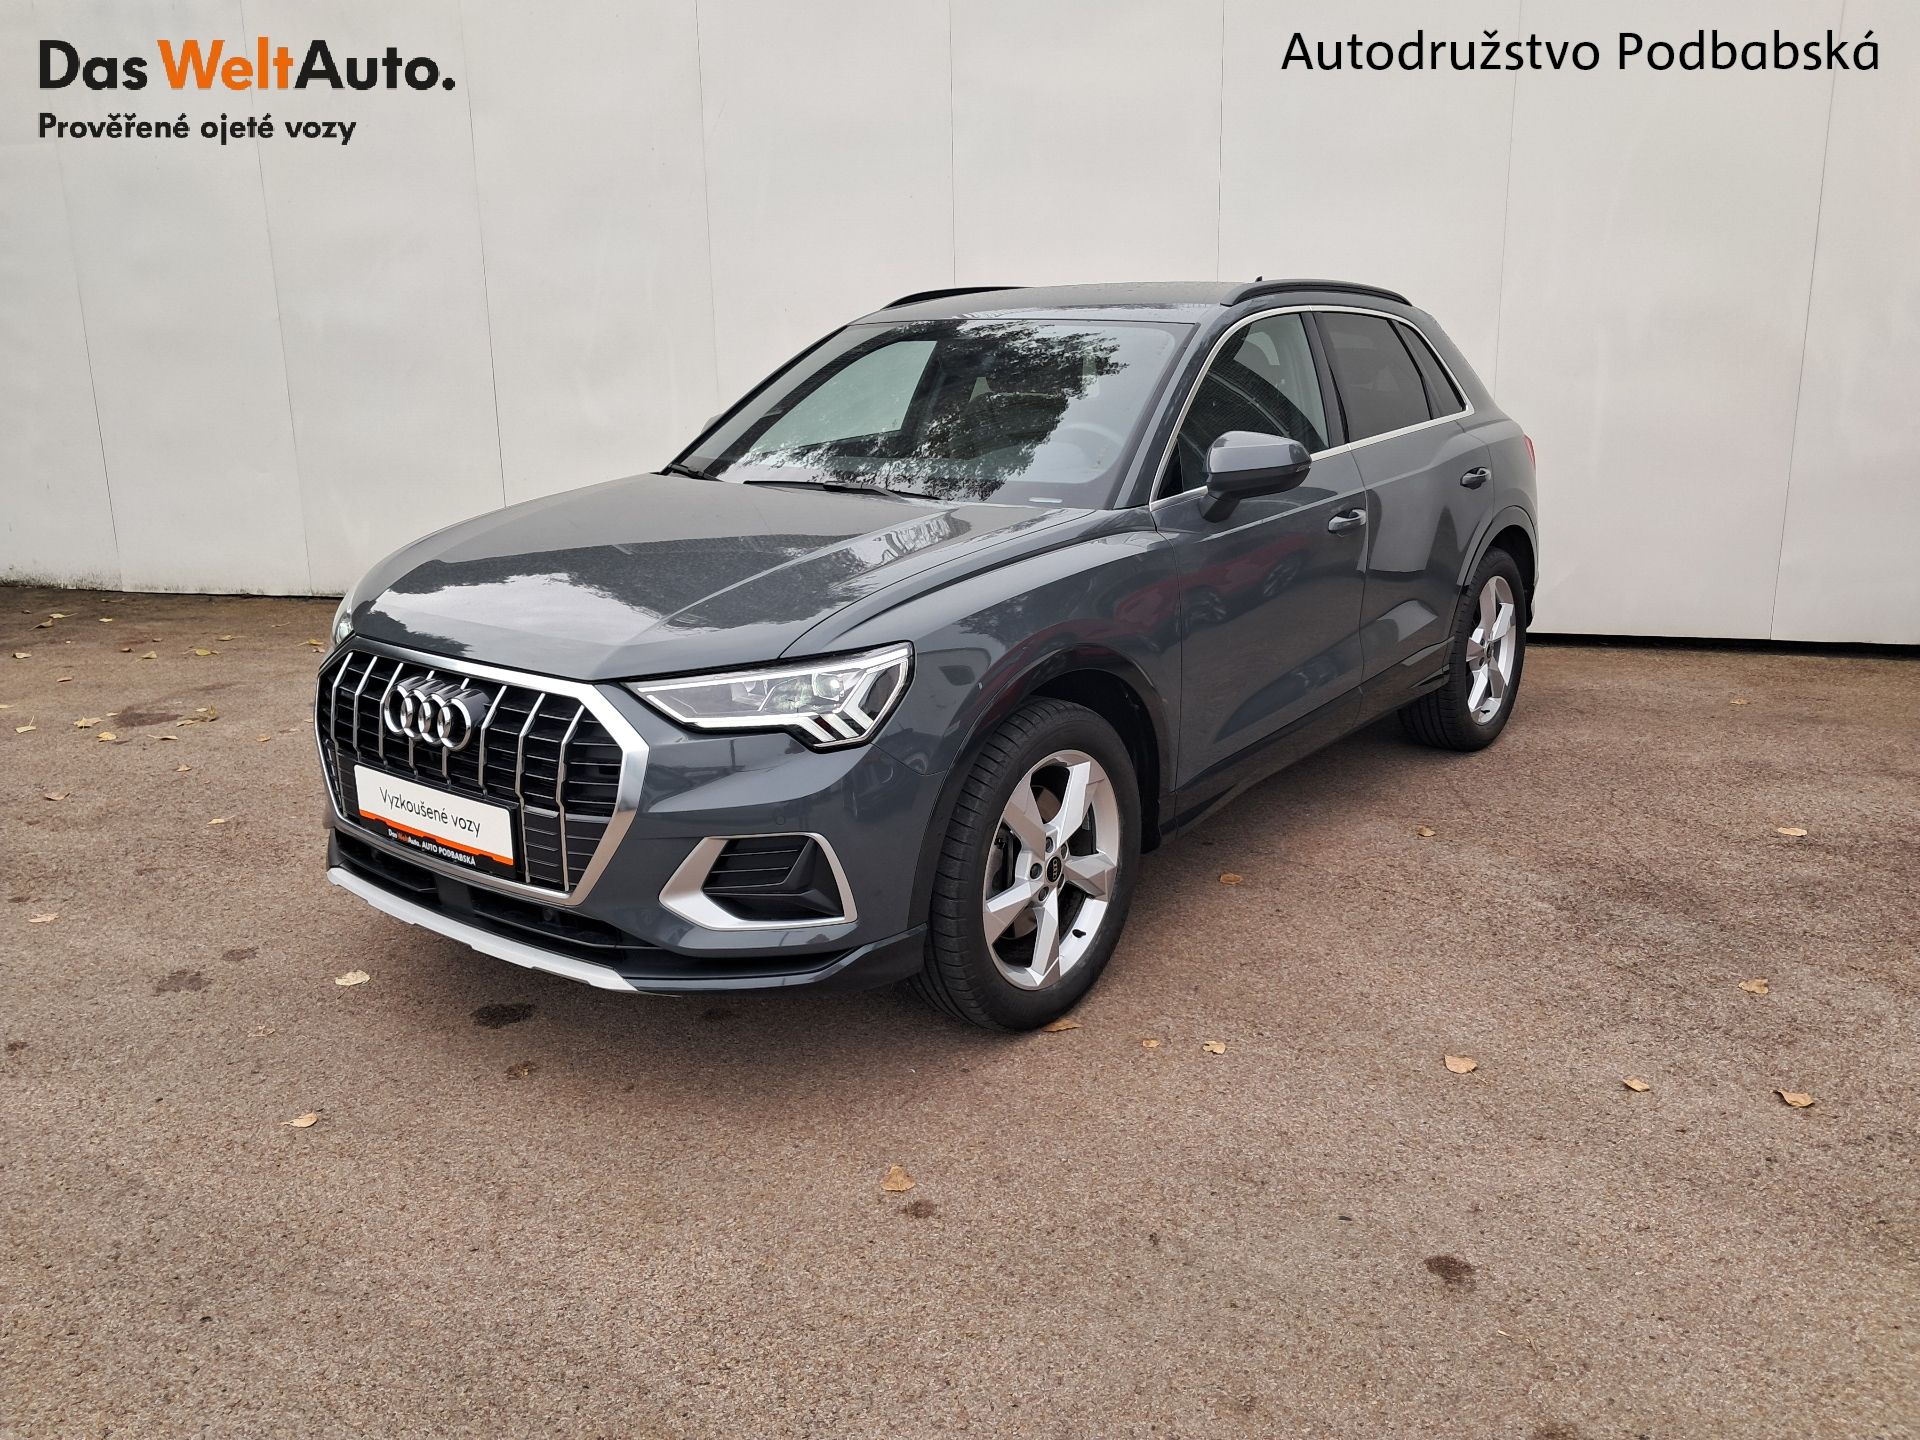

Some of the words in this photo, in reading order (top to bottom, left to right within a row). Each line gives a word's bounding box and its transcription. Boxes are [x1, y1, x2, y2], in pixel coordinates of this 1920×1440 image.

[379, 786, 448, 825] Vyzkoušené
[451, 814, 481, 838] vozy
[421, 840, 438, 853] AUTO
